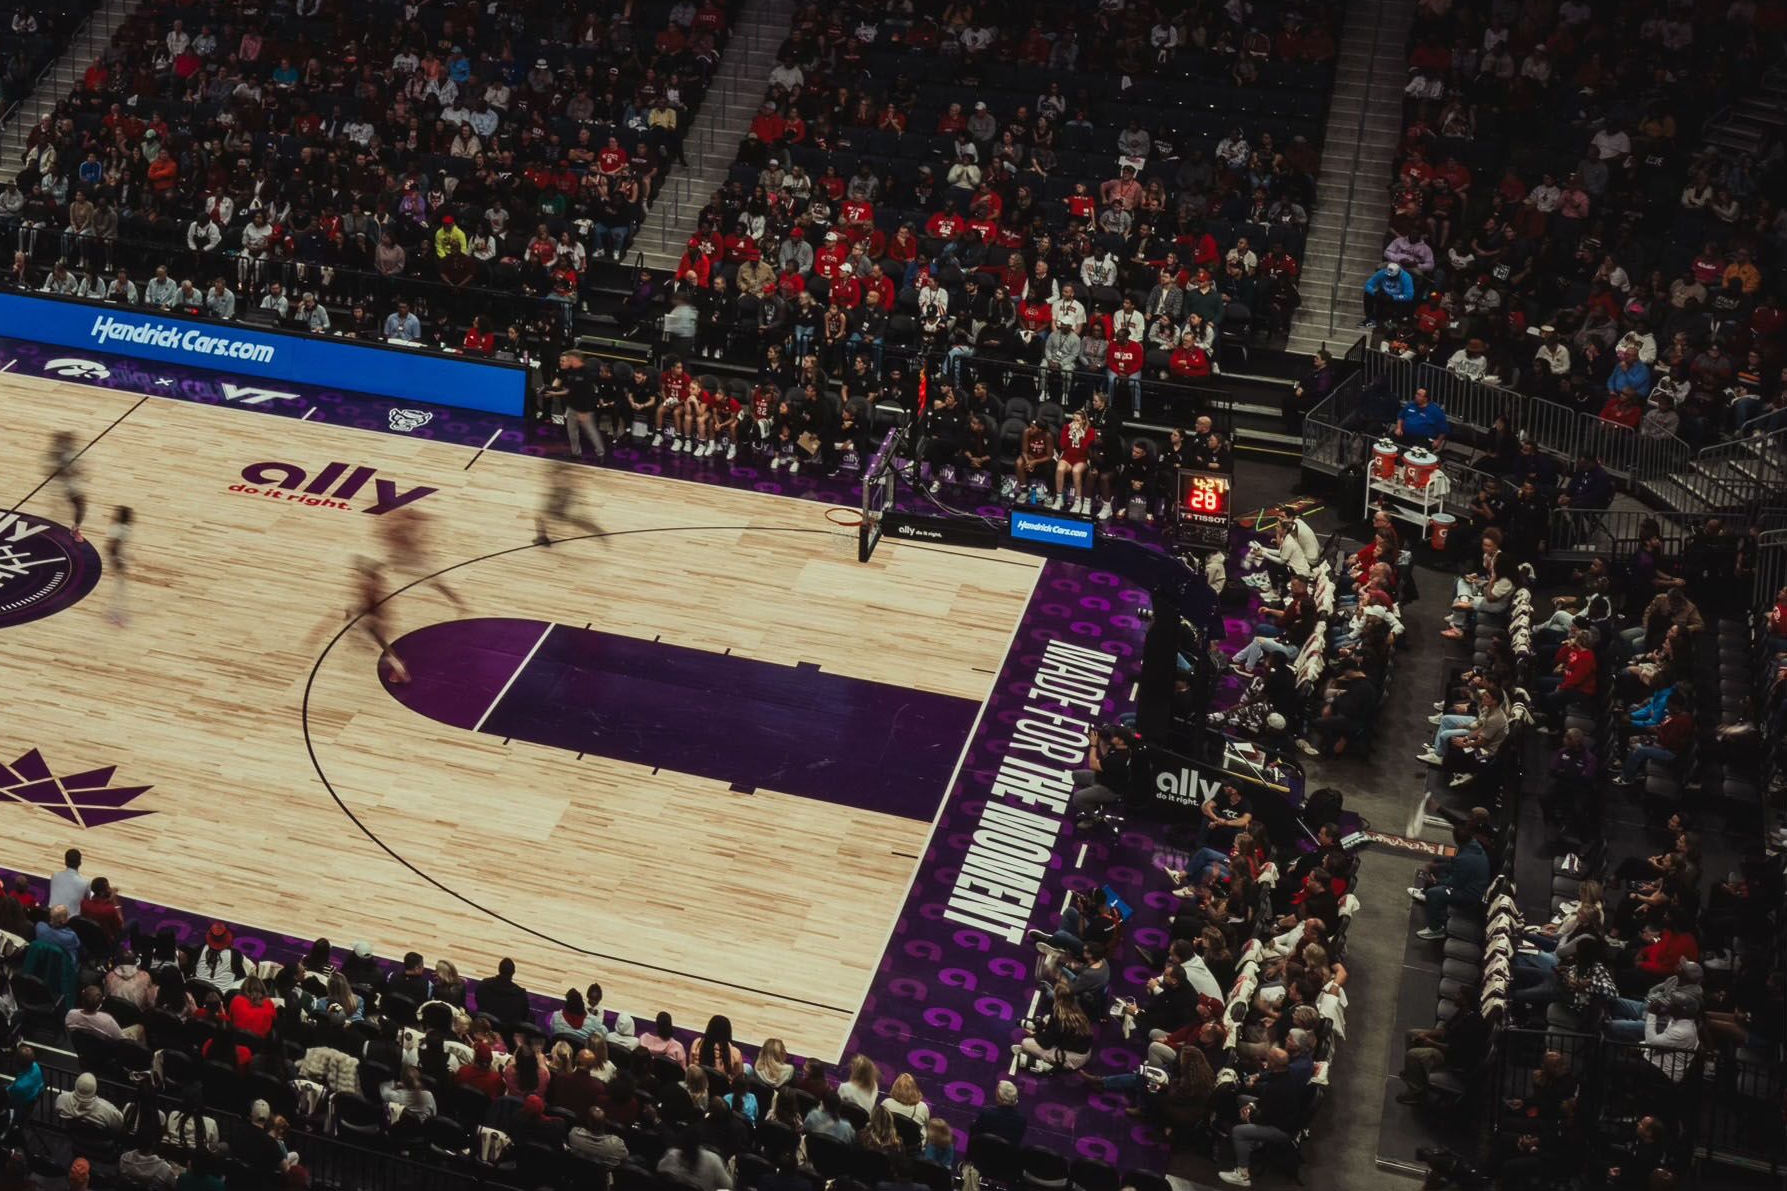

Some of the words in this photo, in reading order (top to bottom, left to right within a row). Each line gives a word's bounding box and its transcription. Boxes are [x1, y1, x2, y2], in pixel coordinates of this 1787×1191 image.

[1375, 456, 1382, 465] G
[1408, 467, 1416, 476] G
[228, 483, 258, 496] do
[263, 487, 283, 499] it
[288, 493, 353, 512] right.
[241, 461, 439, 516] ally
[1190, 489, 1217, 511] 28
[898, 525, 915, 536] ally
[1194, 513, 1227, 525] TISSOT
[1438, 528, 1448, 537] G
[1027, 639, 1117, 716] MADE
[1009, 705, 1090, 764] FOR
[990, 755, 1075, 814] THE
[1156, 767, 1222, 806] ally
[1156, 792, 1167, 800] do
[1176, 796, 1200, 807] right.
[943, 800, 1061, 945] MOMENT
